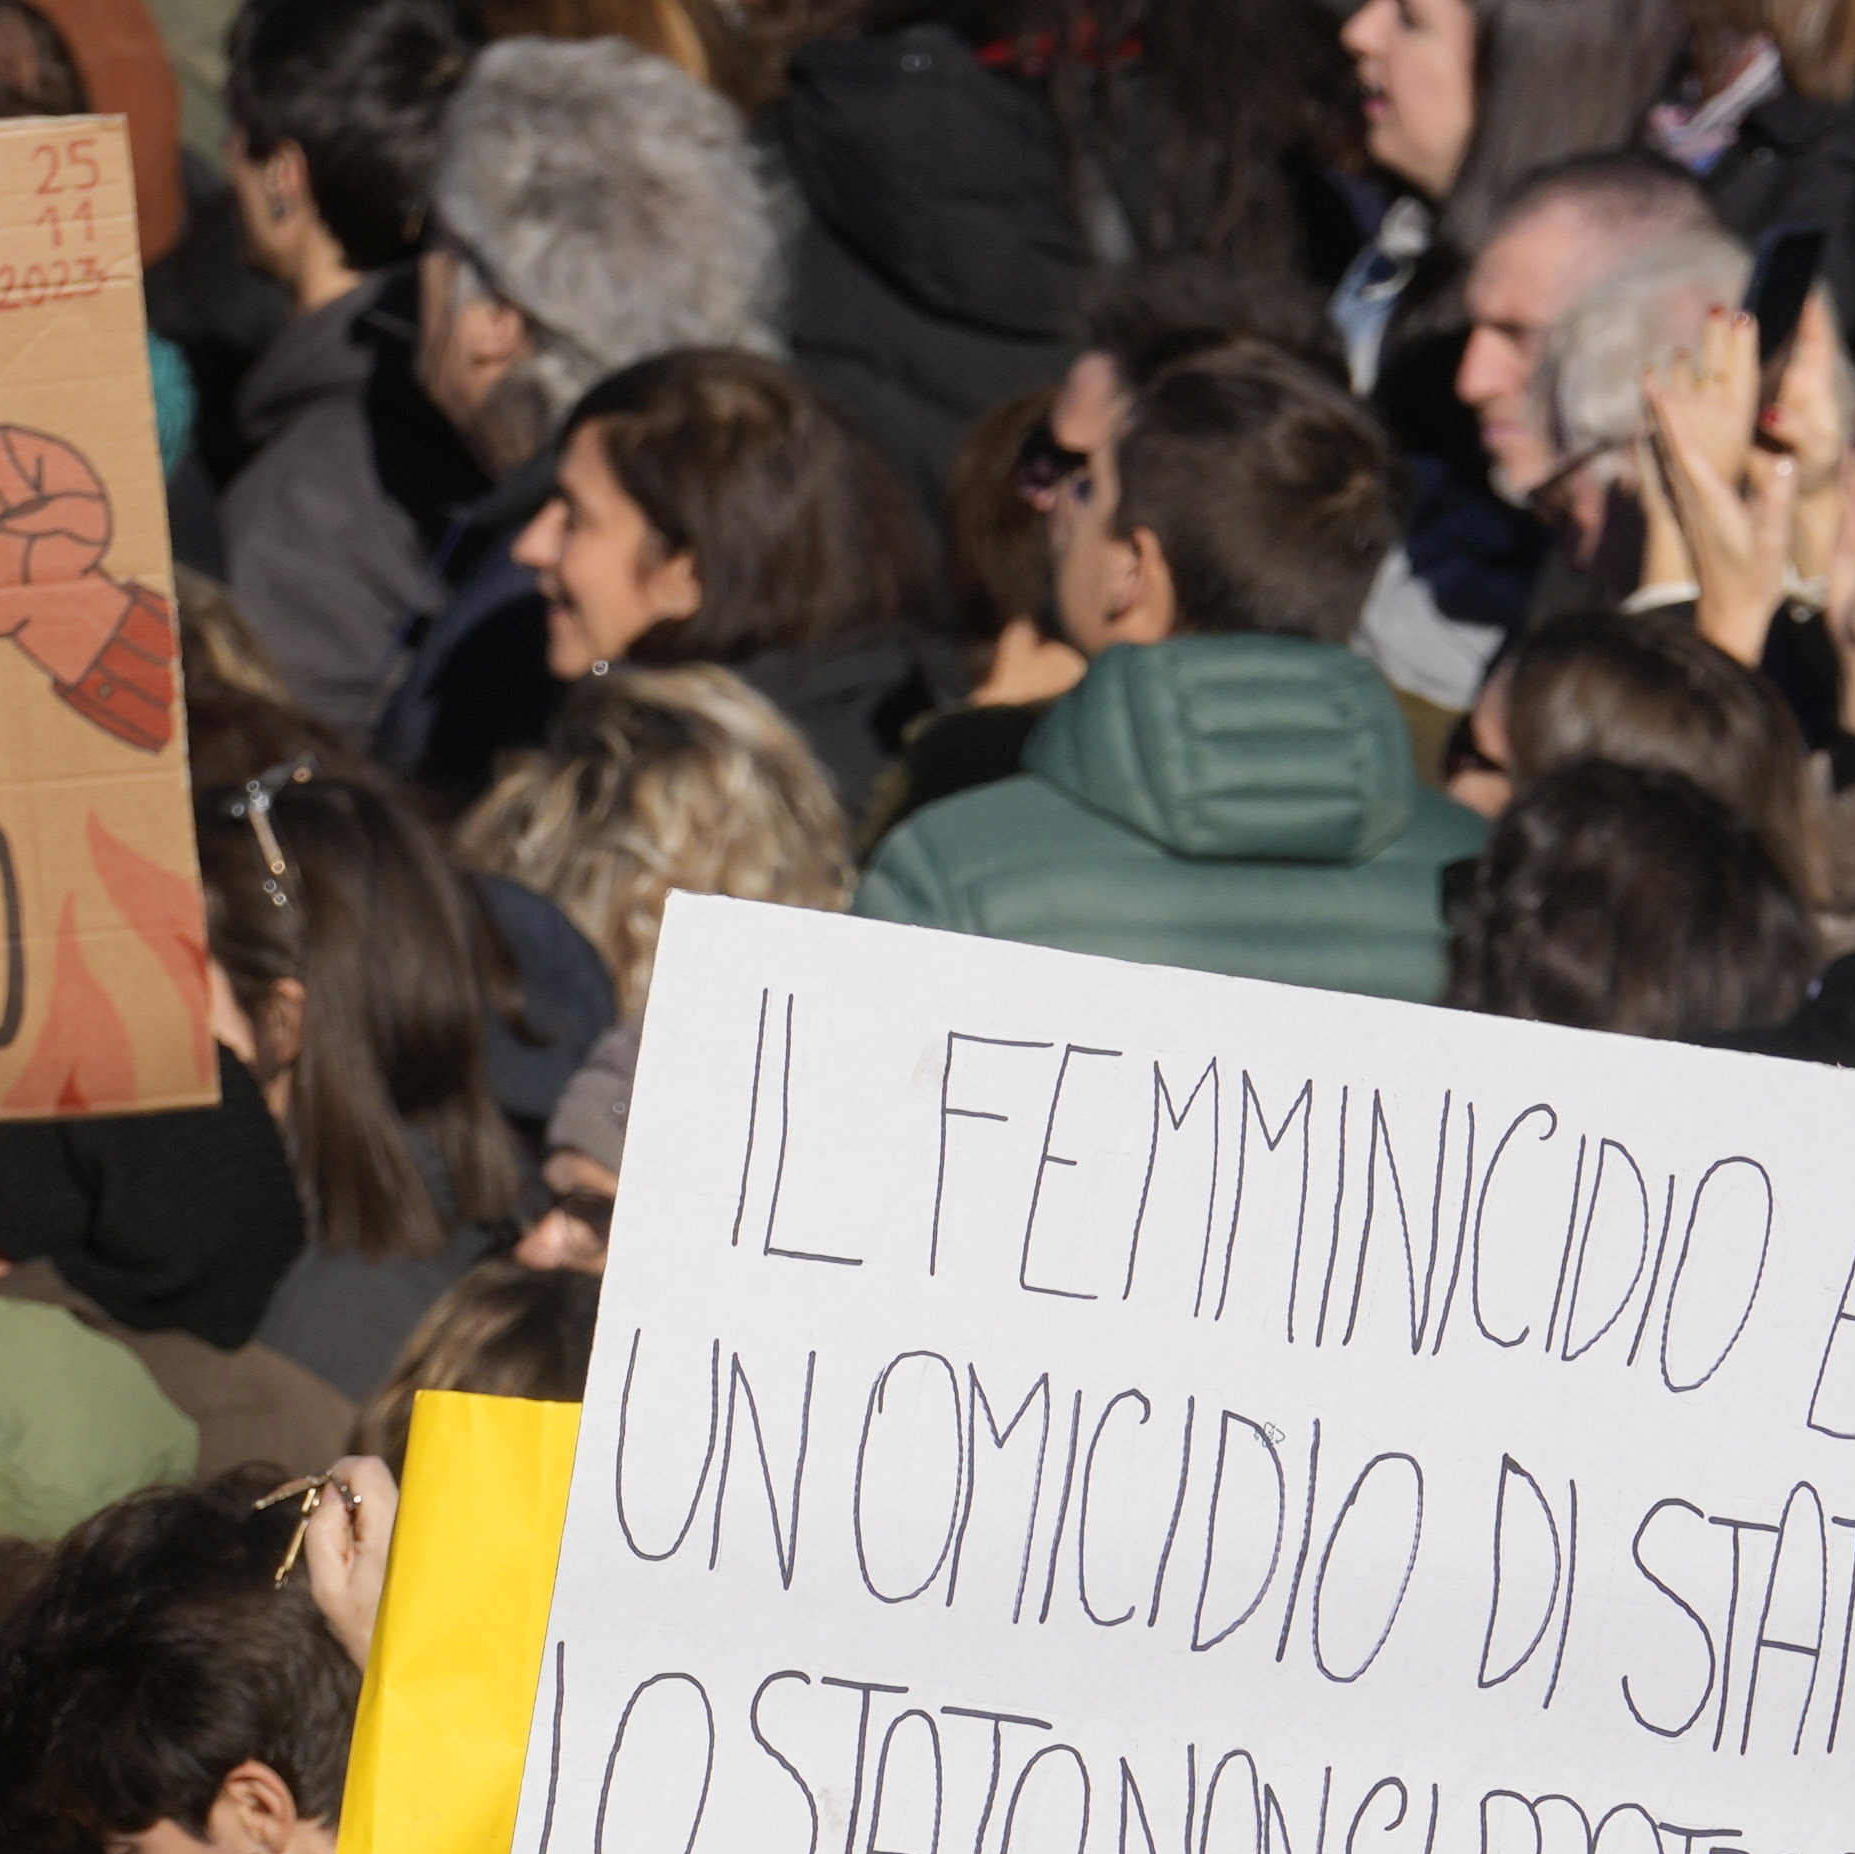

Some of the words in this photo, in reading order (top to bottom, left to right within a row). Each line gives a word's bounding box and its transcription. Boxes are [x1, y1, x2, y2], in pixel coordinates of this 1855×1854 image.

[30, 137, 102, 197] 25
[33, 198, 97, 248] 11
[731, 987, 865, 1266] IL
[929, 1030, 1775, 1394] FEMMINICIDIO
[615, 1327, 817, 1591] UN
[853, 1350, 1425, 1690] OMICIDIO
[1477, 1452, 1579, 1711] DI
